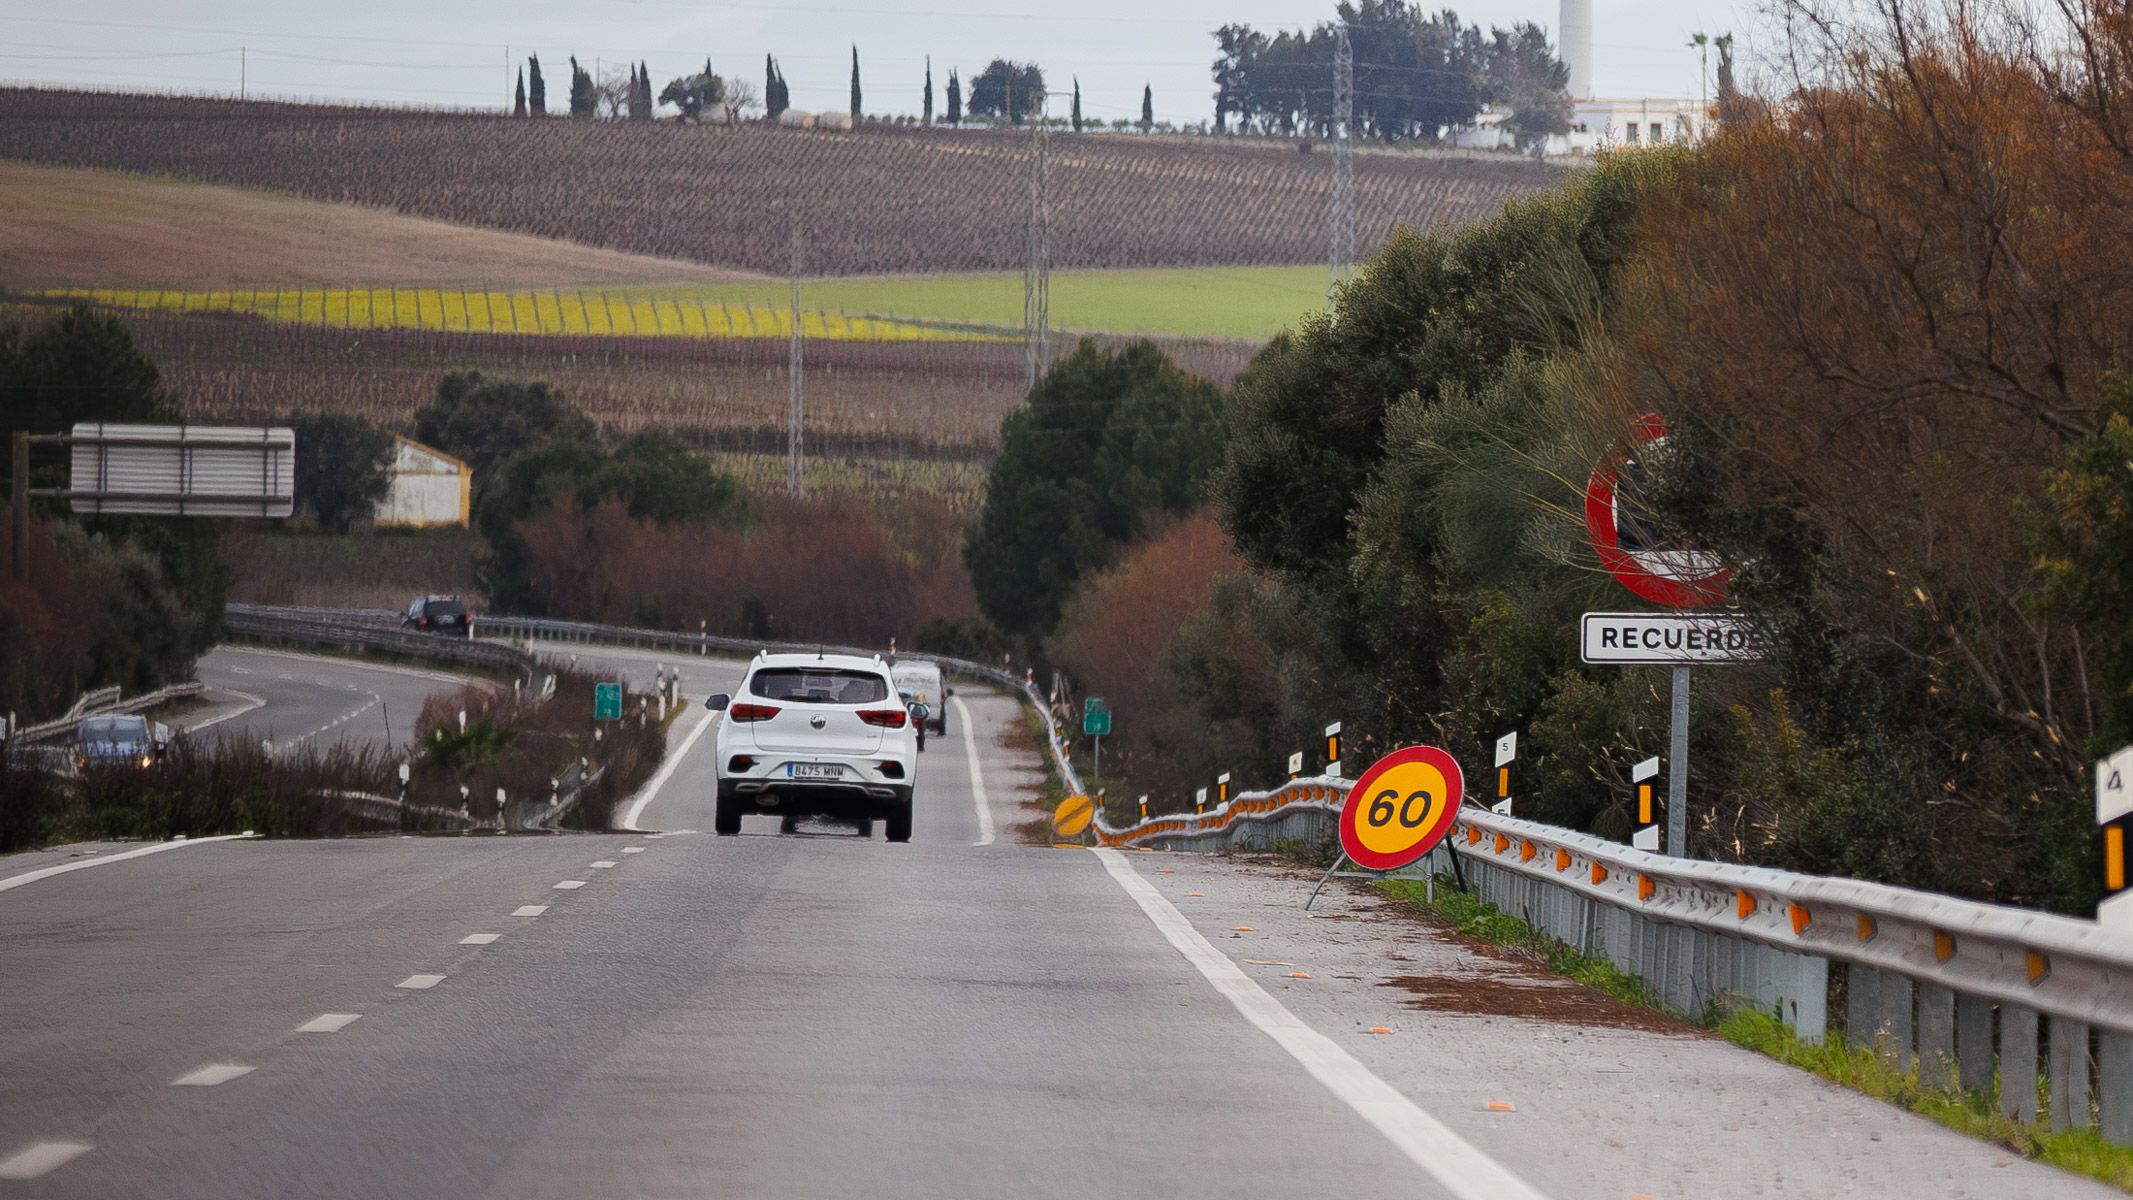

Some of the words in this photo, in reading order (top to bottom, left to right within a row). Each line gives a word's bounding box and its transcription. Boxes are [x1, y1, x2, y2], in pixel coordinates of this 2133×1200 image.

[1601, 627, 1766, 651] RECUERD
[1502, 742, 1509, 752] 5
[2107, 770, 2123, 791] 4
[1368, 789, 1432, 828] 60
